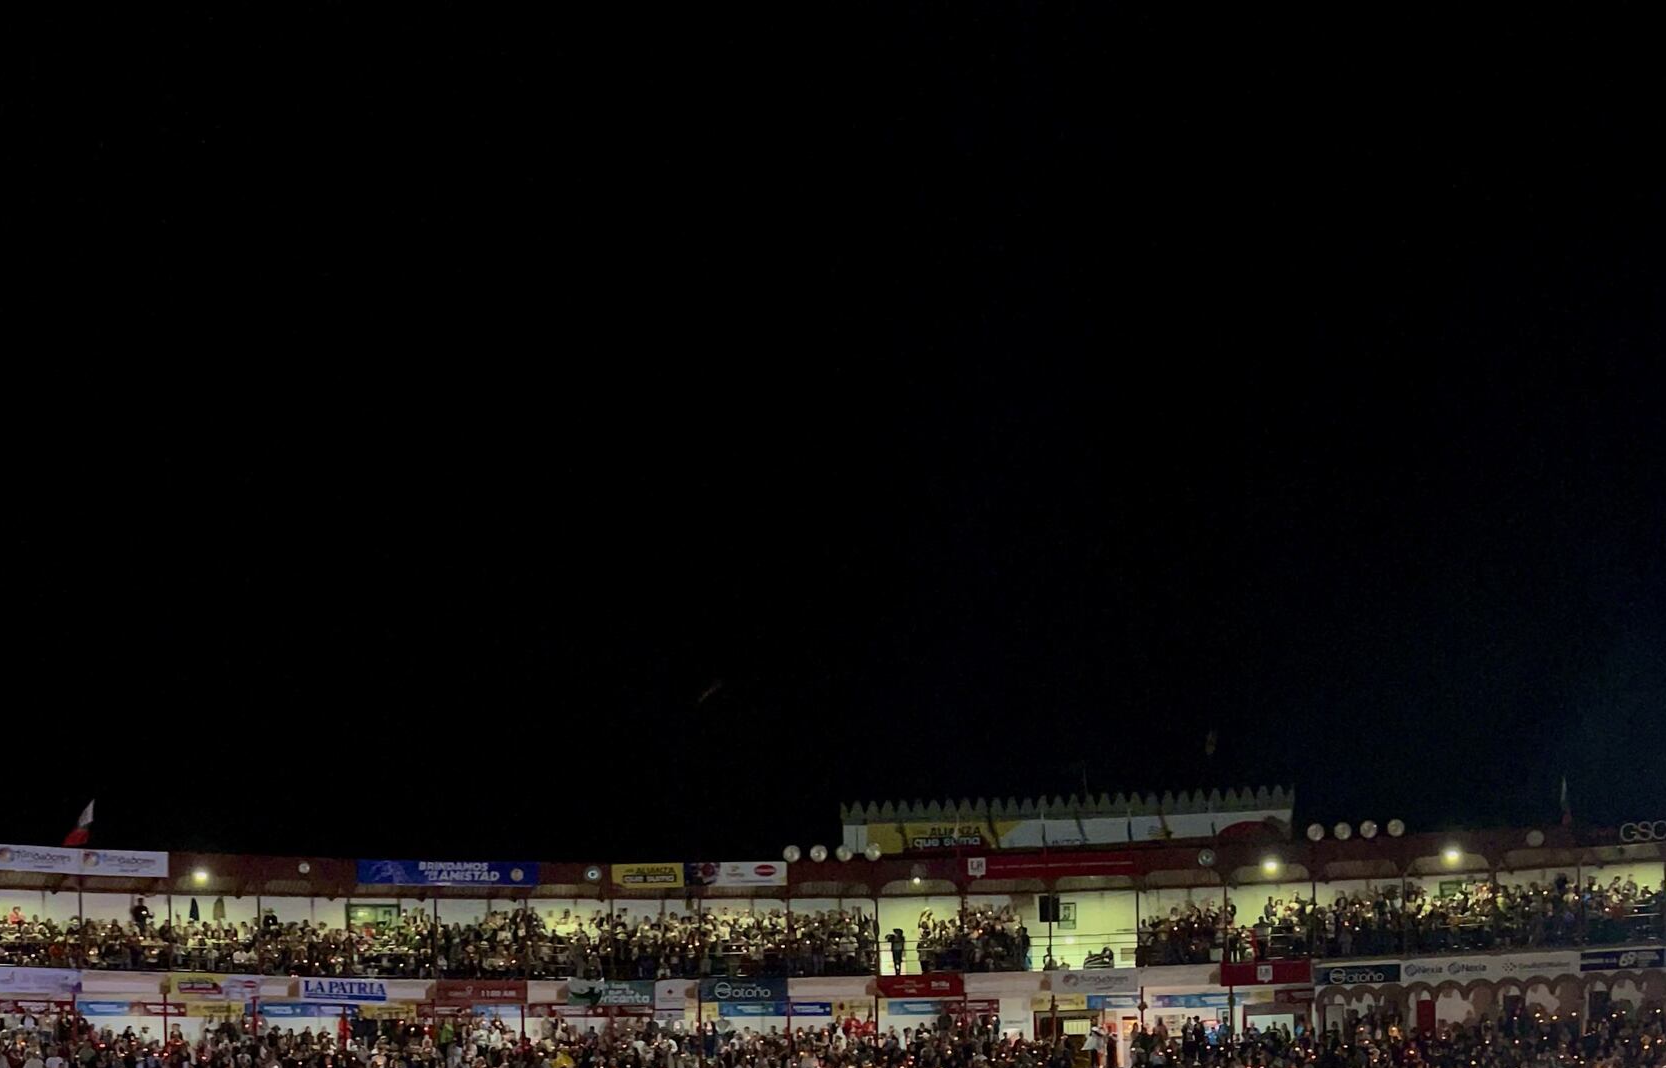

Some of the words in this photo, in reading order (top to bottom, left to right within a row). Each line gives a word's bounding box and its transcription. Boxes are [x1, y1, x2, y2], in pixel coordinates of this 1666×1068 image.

[418, 861, 489, 872] BRINDAMOS
[439, 871, 501, 881] AMISTAD
[1619, 951, 1639, 967] 69
[304, 980, 325, 993] LA
[329, 981, 386, 995] PATRIA
[732, 985, 772, 999] otoño
